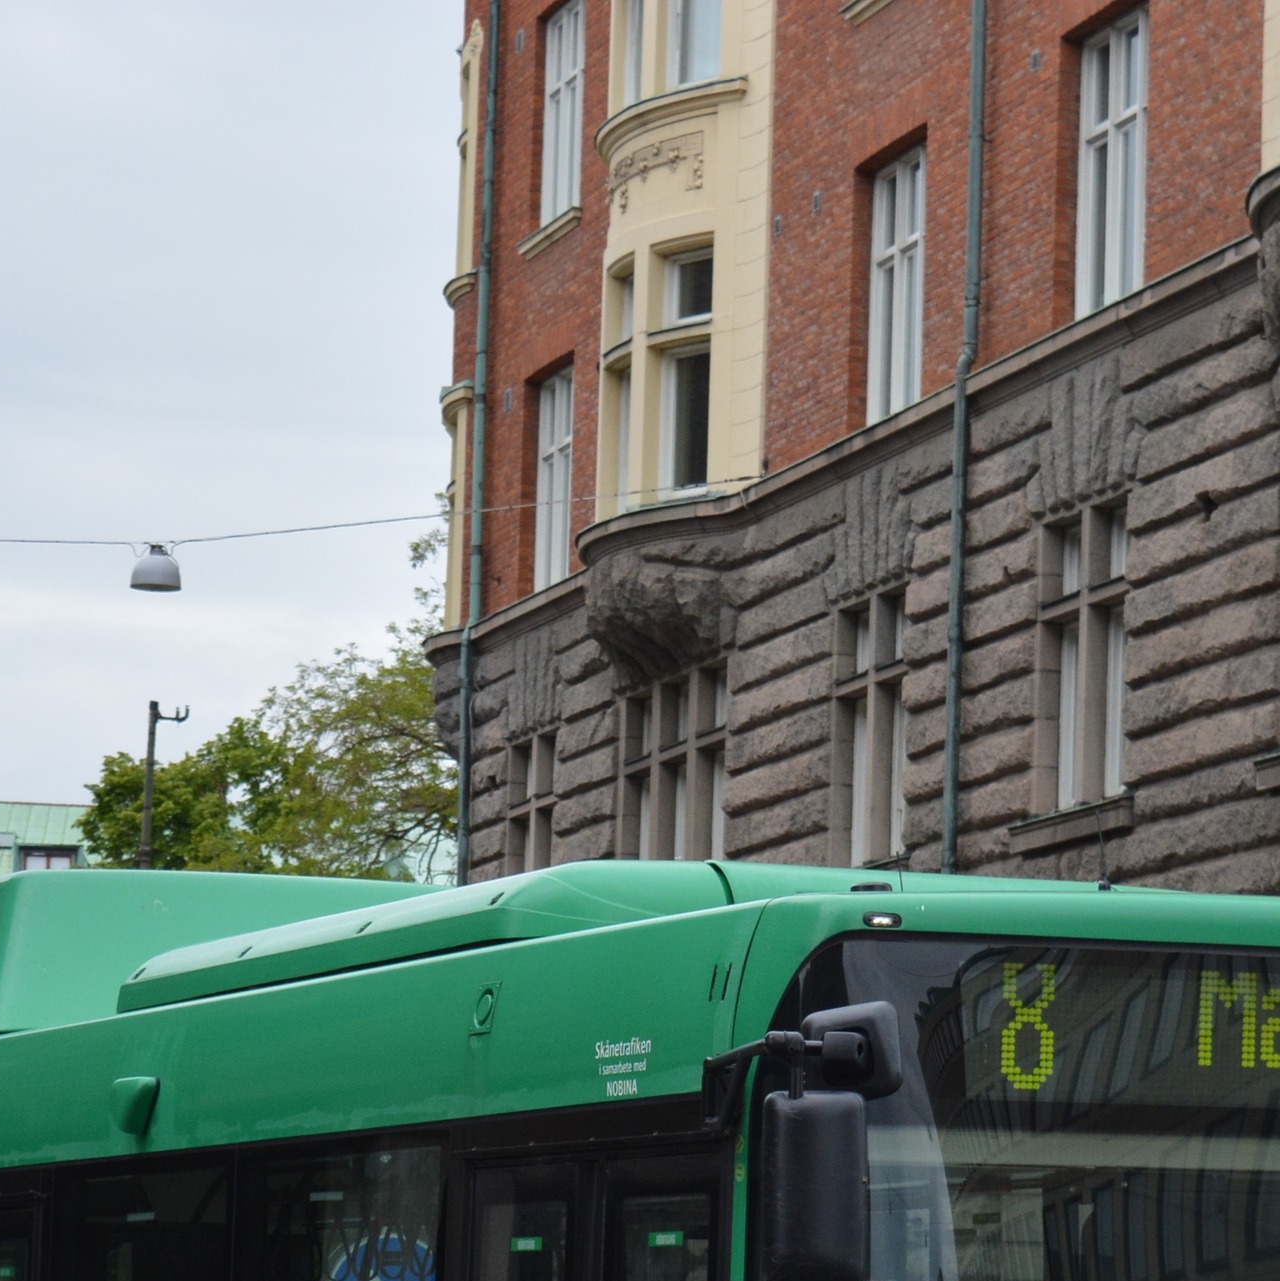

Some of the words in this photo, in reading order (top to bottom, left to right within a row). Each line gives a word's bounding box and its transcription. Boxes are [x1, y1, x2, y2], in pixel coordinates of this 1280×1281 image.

[1001, 962, 1056, 1090] 8
[595, 1036, 652, 1060] Skånetrafiken
[602, 1060, 633, 1076] samarbete
[633, 1057, 647, 1073] med
[606, 1078, 638, 1097] NOBINA
